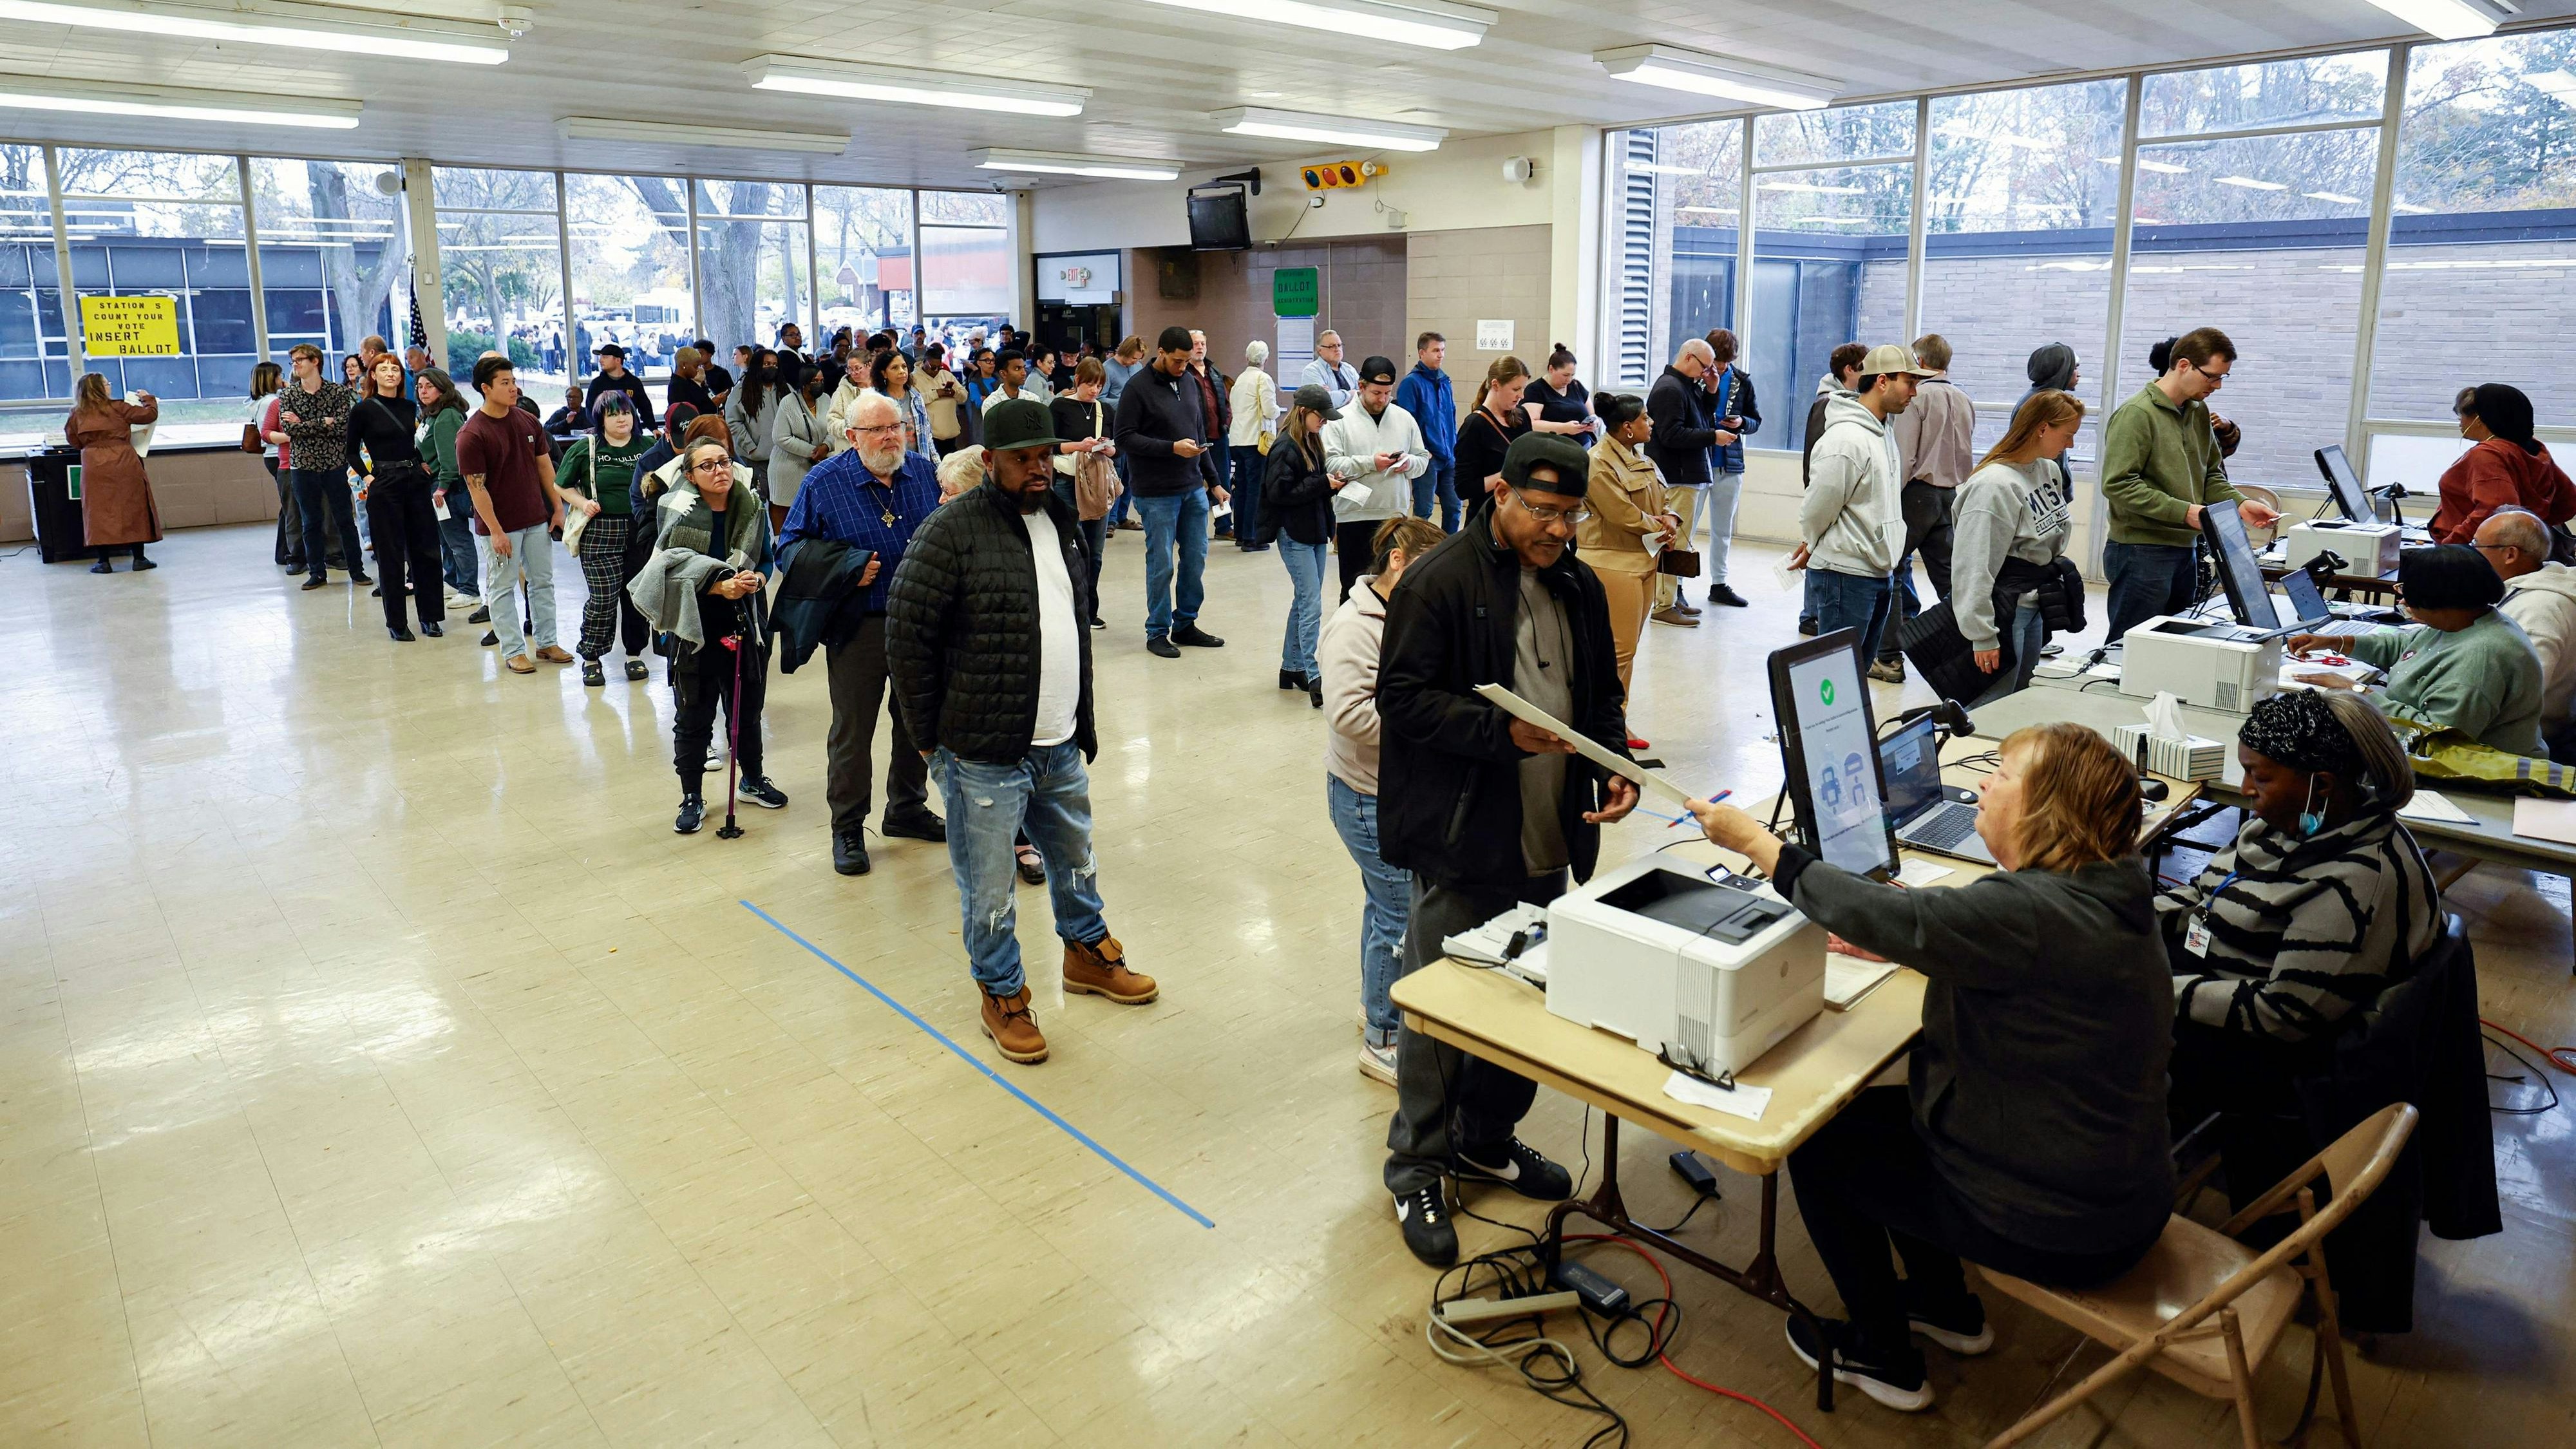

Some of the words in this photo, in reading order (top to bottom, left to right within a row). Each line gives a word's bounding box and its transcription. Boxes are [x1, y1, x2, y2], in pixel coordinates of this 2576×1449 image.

[1068, 268, 1078, 281] EXIT
[1278, 281, 1309, 292] BALLOT
[90, 332, 140, 341] INSERT
[119, 345, 171, 354] BALLOT
